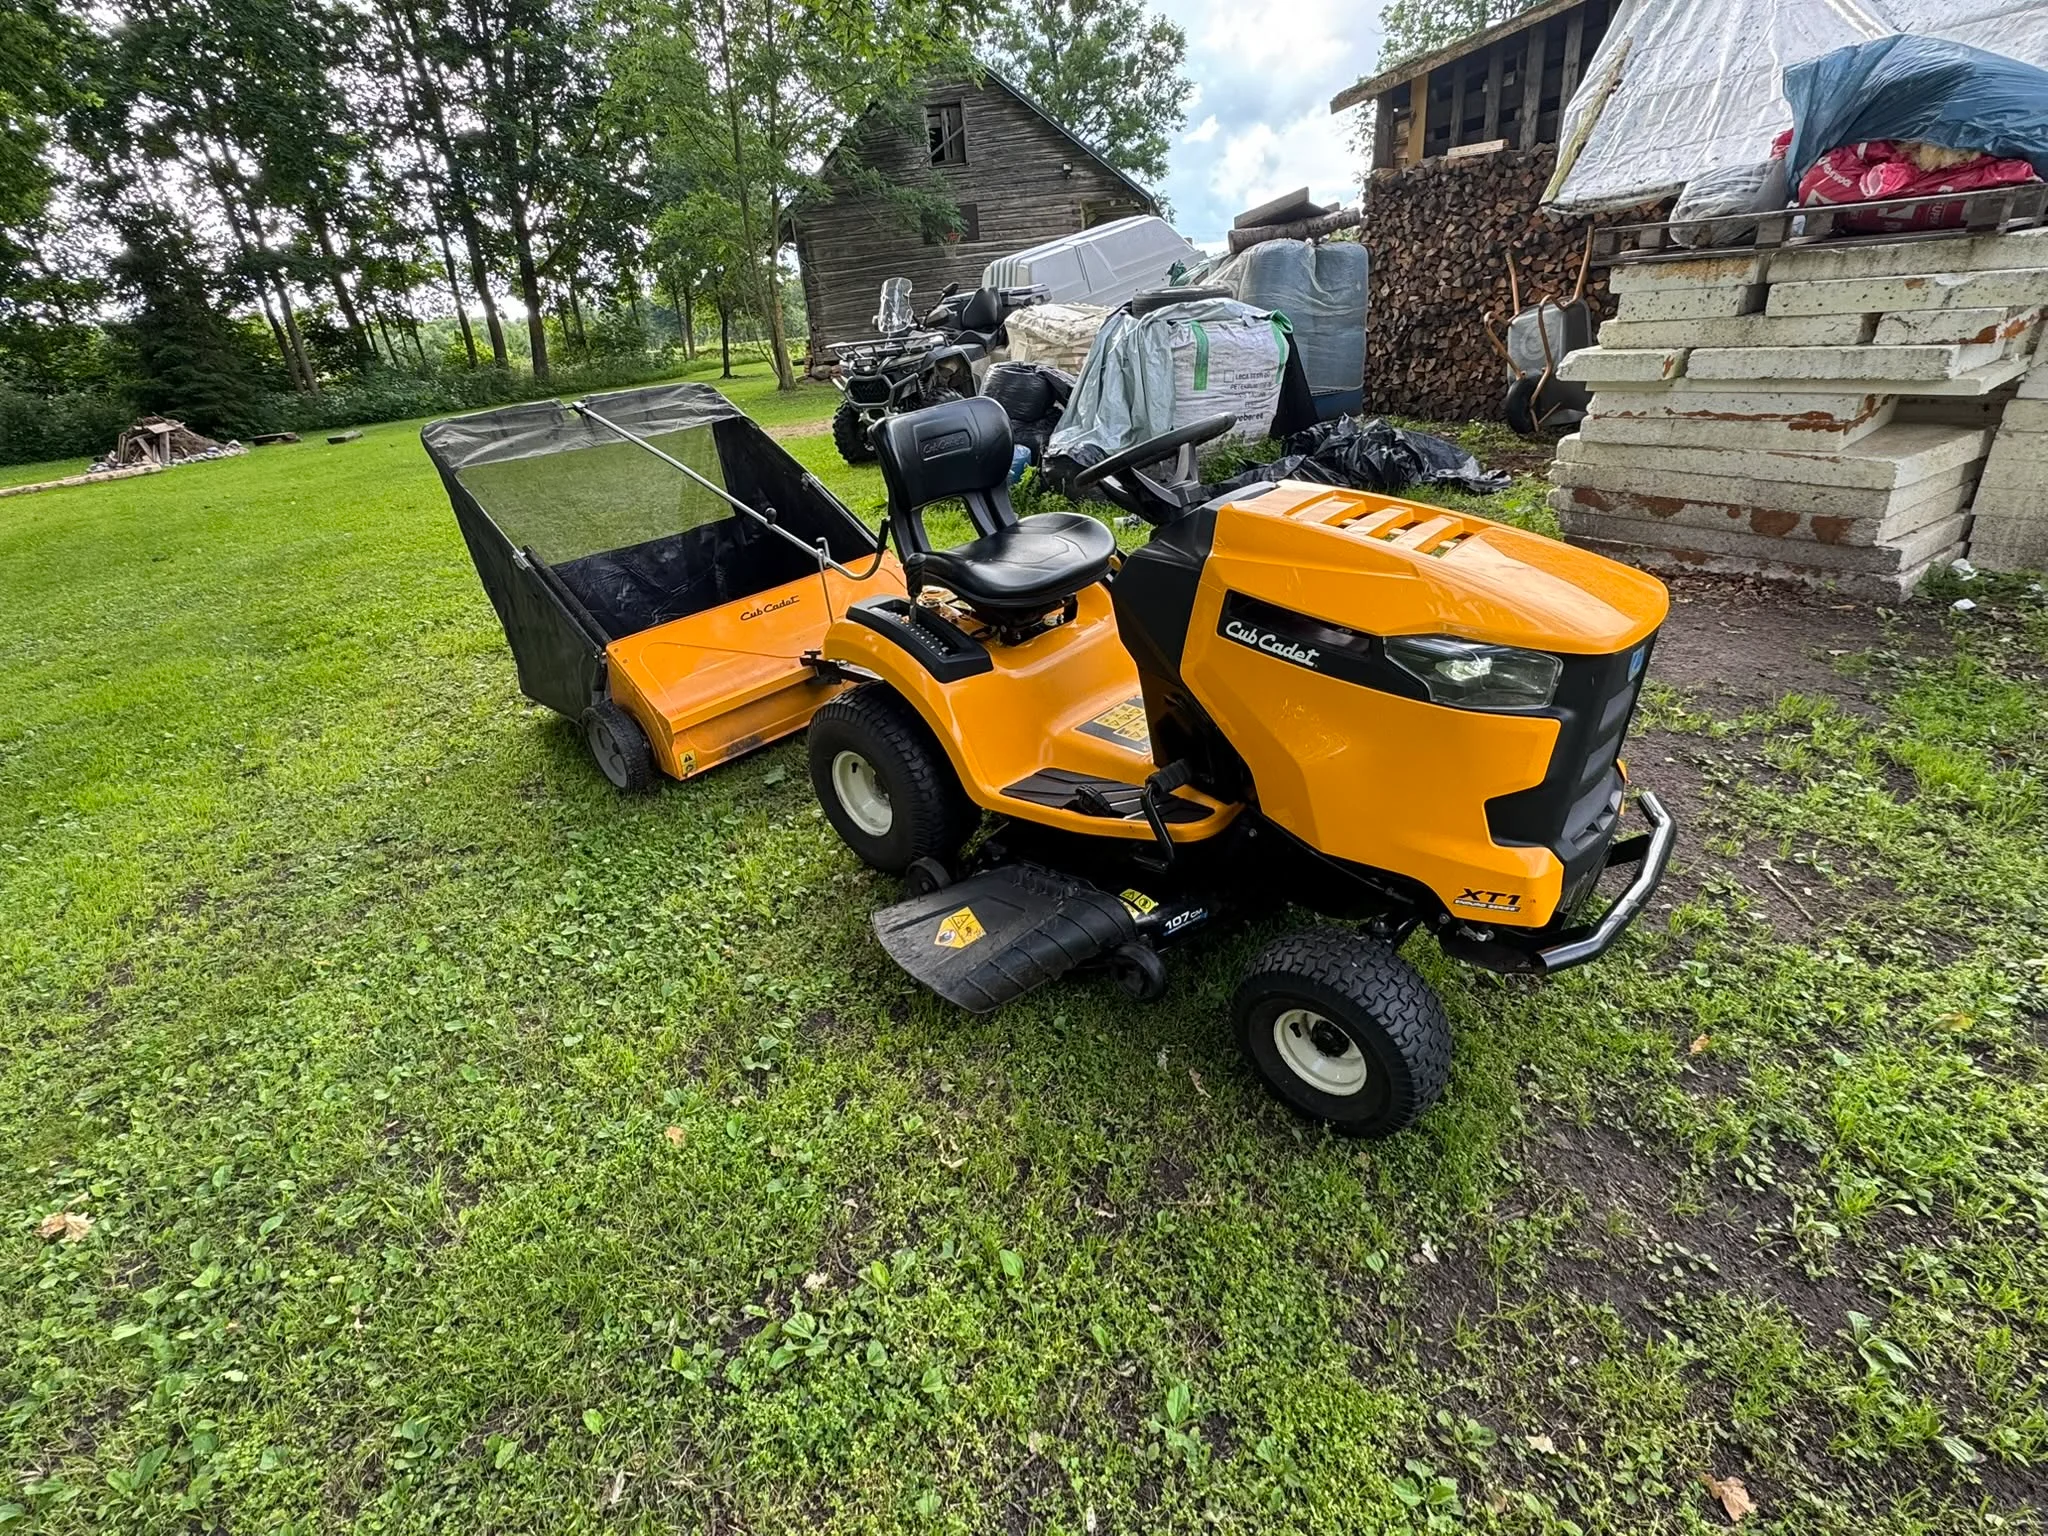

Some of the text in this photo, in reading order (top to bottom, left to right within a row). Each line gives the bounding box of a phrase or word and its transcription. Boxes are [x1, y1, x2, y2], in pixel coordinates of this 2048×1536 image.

[740, 595, 801, 621] Cub Cadet
[1225, 621, 1320, 667] Cub Cadet
[1457, 888, 1521, 906] XT1
[1165, 911, 1190, 929] 107
